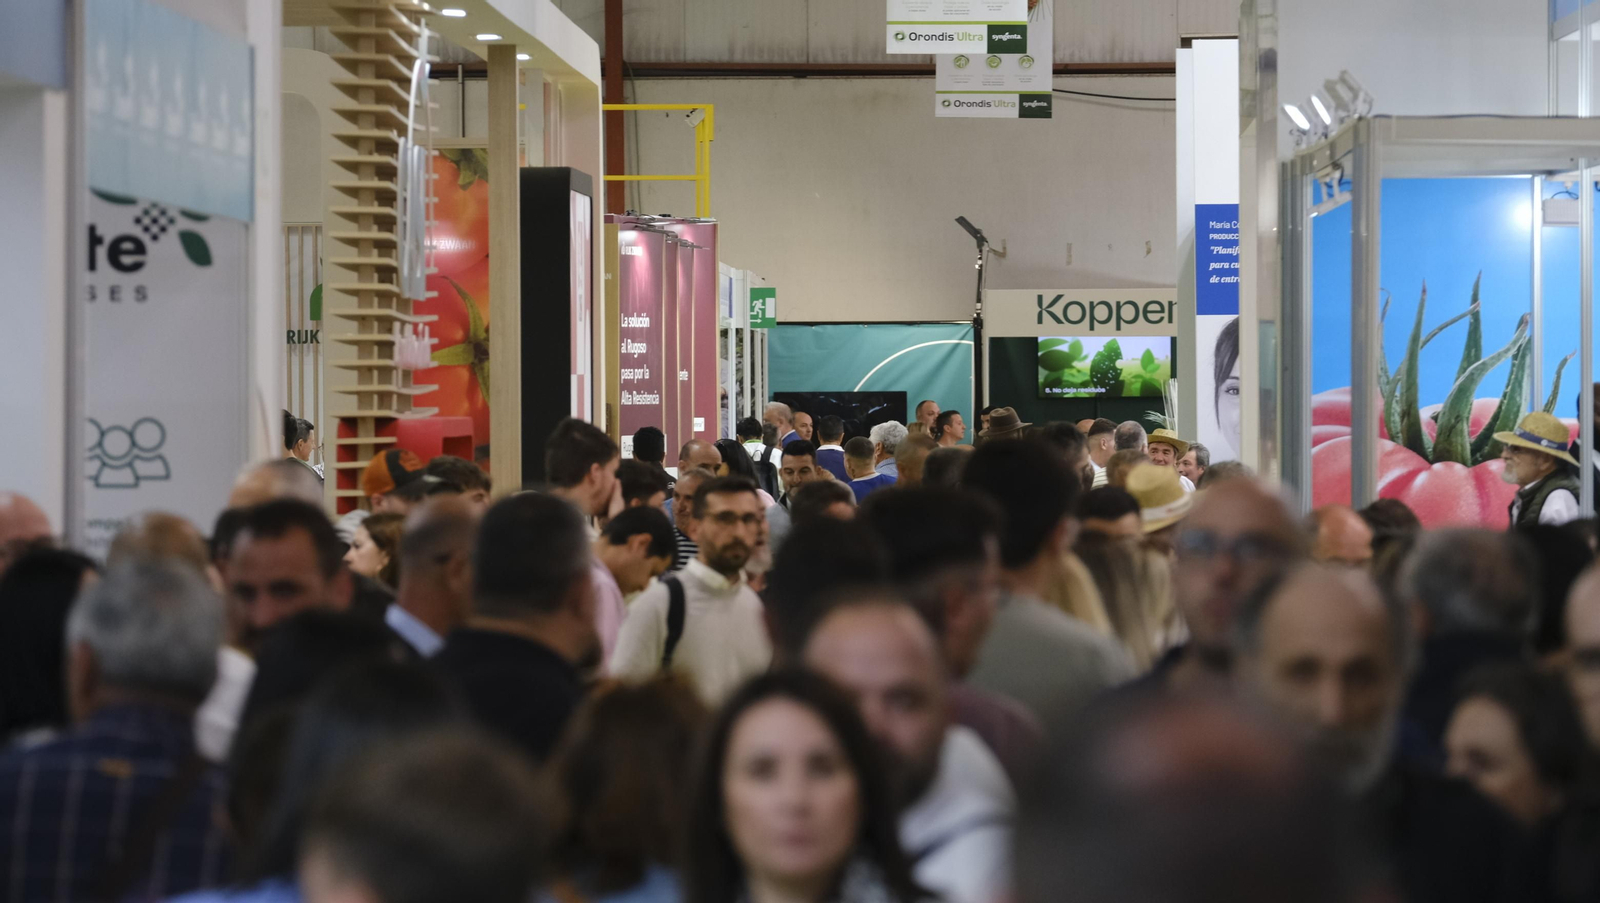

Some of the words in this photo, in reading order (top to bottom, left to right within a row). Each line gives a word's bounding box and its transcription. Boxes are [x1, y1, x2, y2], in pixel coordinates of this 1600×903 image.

[908, 31, 954, 42] Orondis
[957, 32, 984, 42] Ultra
[953, 100, 992, 108] Orondis
[994, 100, 1016, 108] Ultra
[1209, 262, 1230, 271] para
[1209, 275, 1220, 283] de
[621, 313, 628, 327] La
[628, 312, 650, 327] solución
[287, 330, 320, 344] RIJK
[621, 338, 627, 353] al
[628, 339, 647, 358] Rugoso
[621, 368, 634, 383] pasa
[634, 368, 643, 383] por
[644, 364, 650, 379] la
[621, 390, 632, 405] Alta
[633, 390, 660, 404] Resistencia
